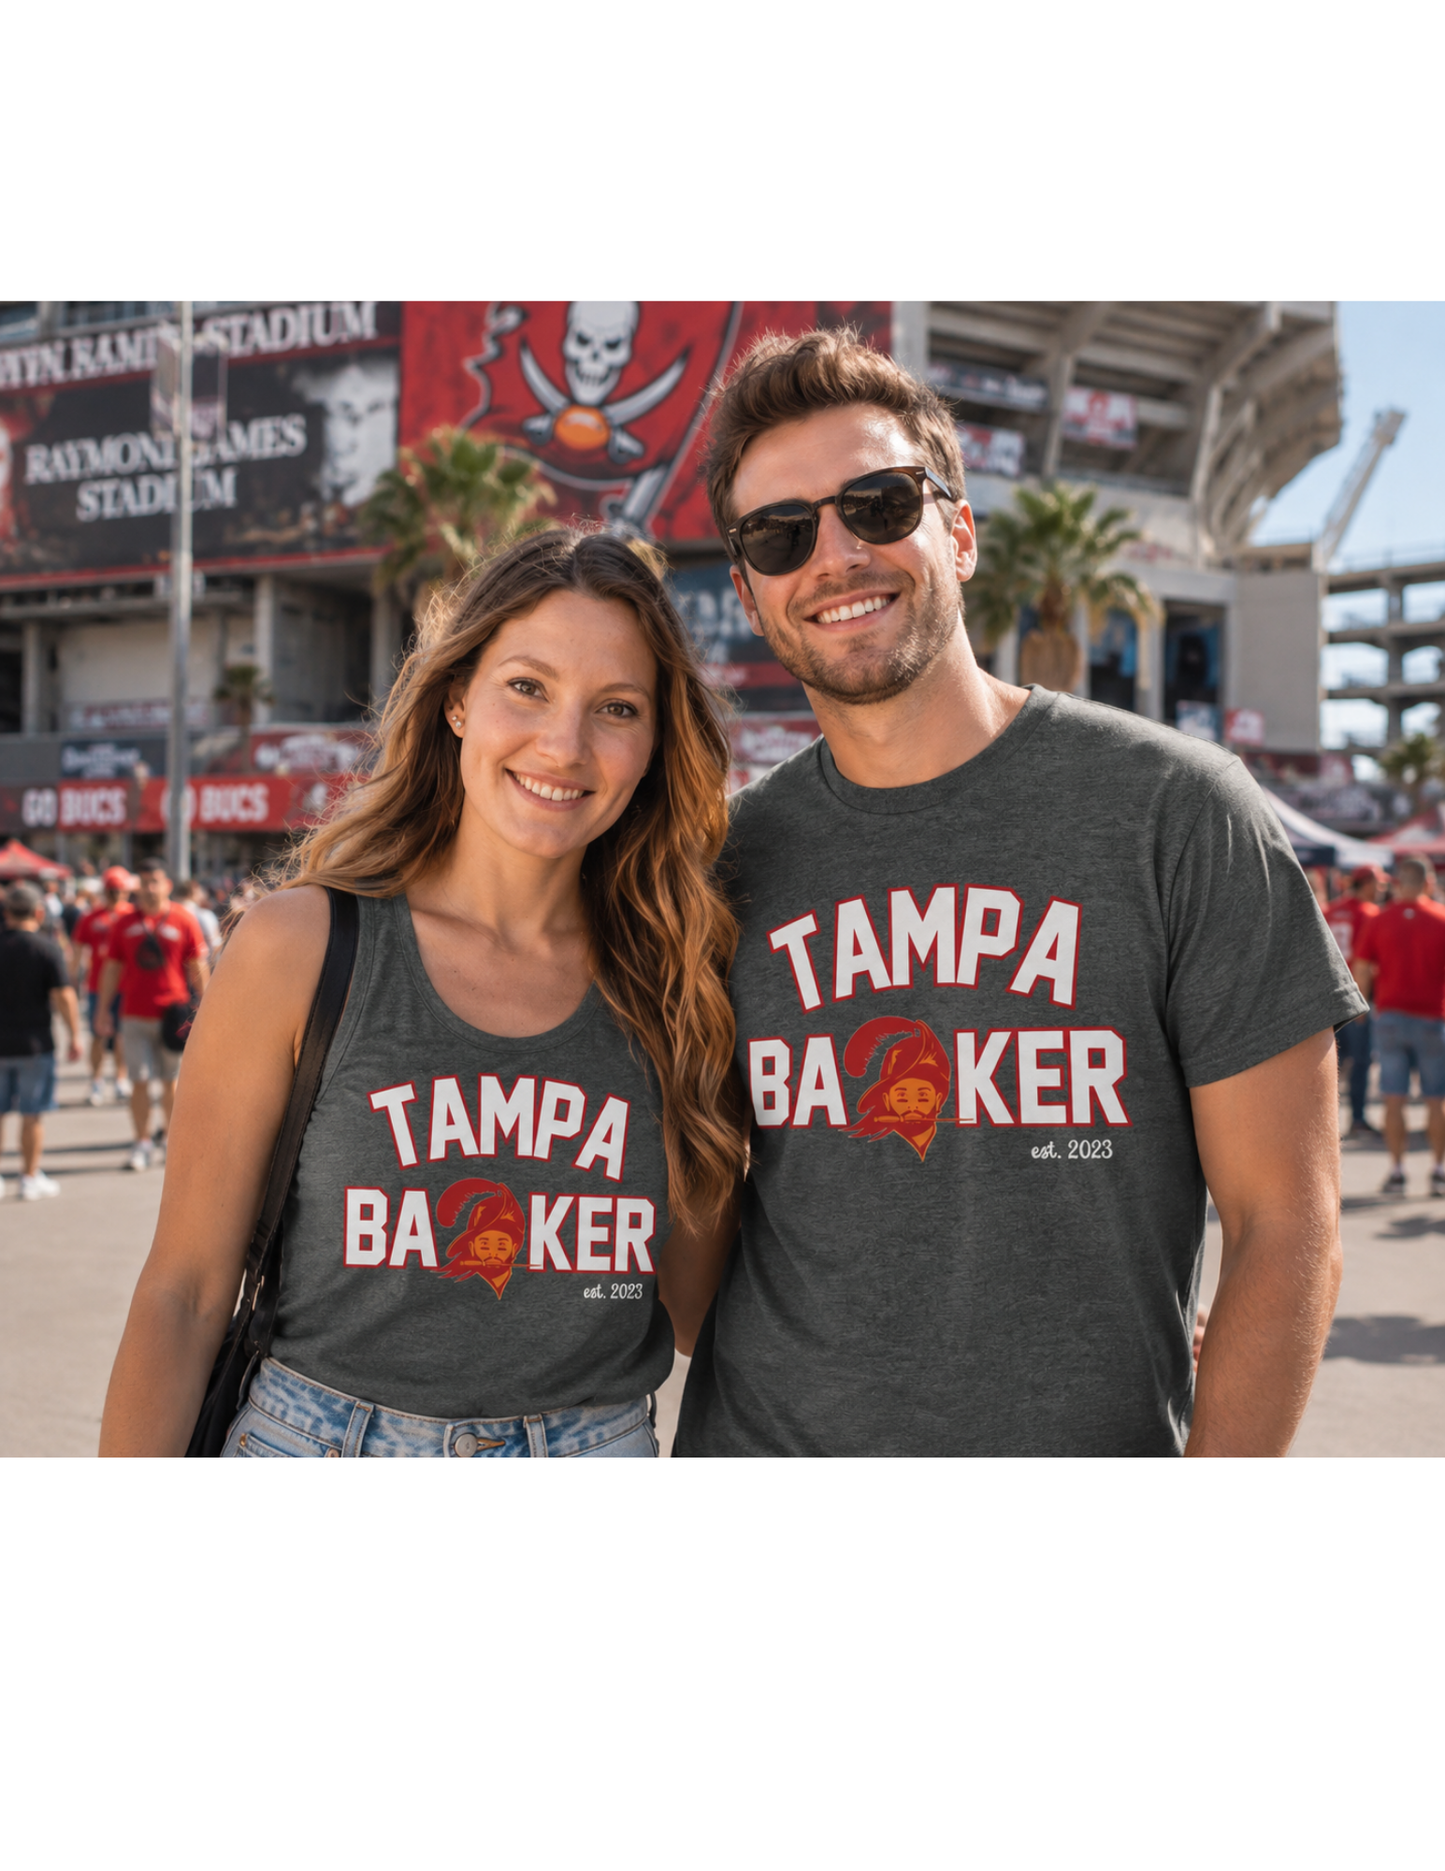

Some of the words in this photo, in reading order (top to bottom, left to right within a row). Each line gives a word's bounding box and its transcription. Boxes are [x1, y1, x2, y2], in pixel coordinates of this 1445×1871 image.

[26, 431, 178, 484] RAYMON
[22, 787, 58, 828] GO
[60, 786, 127, 827] BUCS
[200, 783, 269, 823] BUCS
[766, 883, 1083, 1014] TAMPA
[367, 1073, 631, 1183] TAMPA
[1031, 1141, 1062, 1159] est.
[1068, 1139, 1113, 1159] 2023
[583, 1284, 606, 1299] est.
[610, 1283, 643, 1299] 2023
